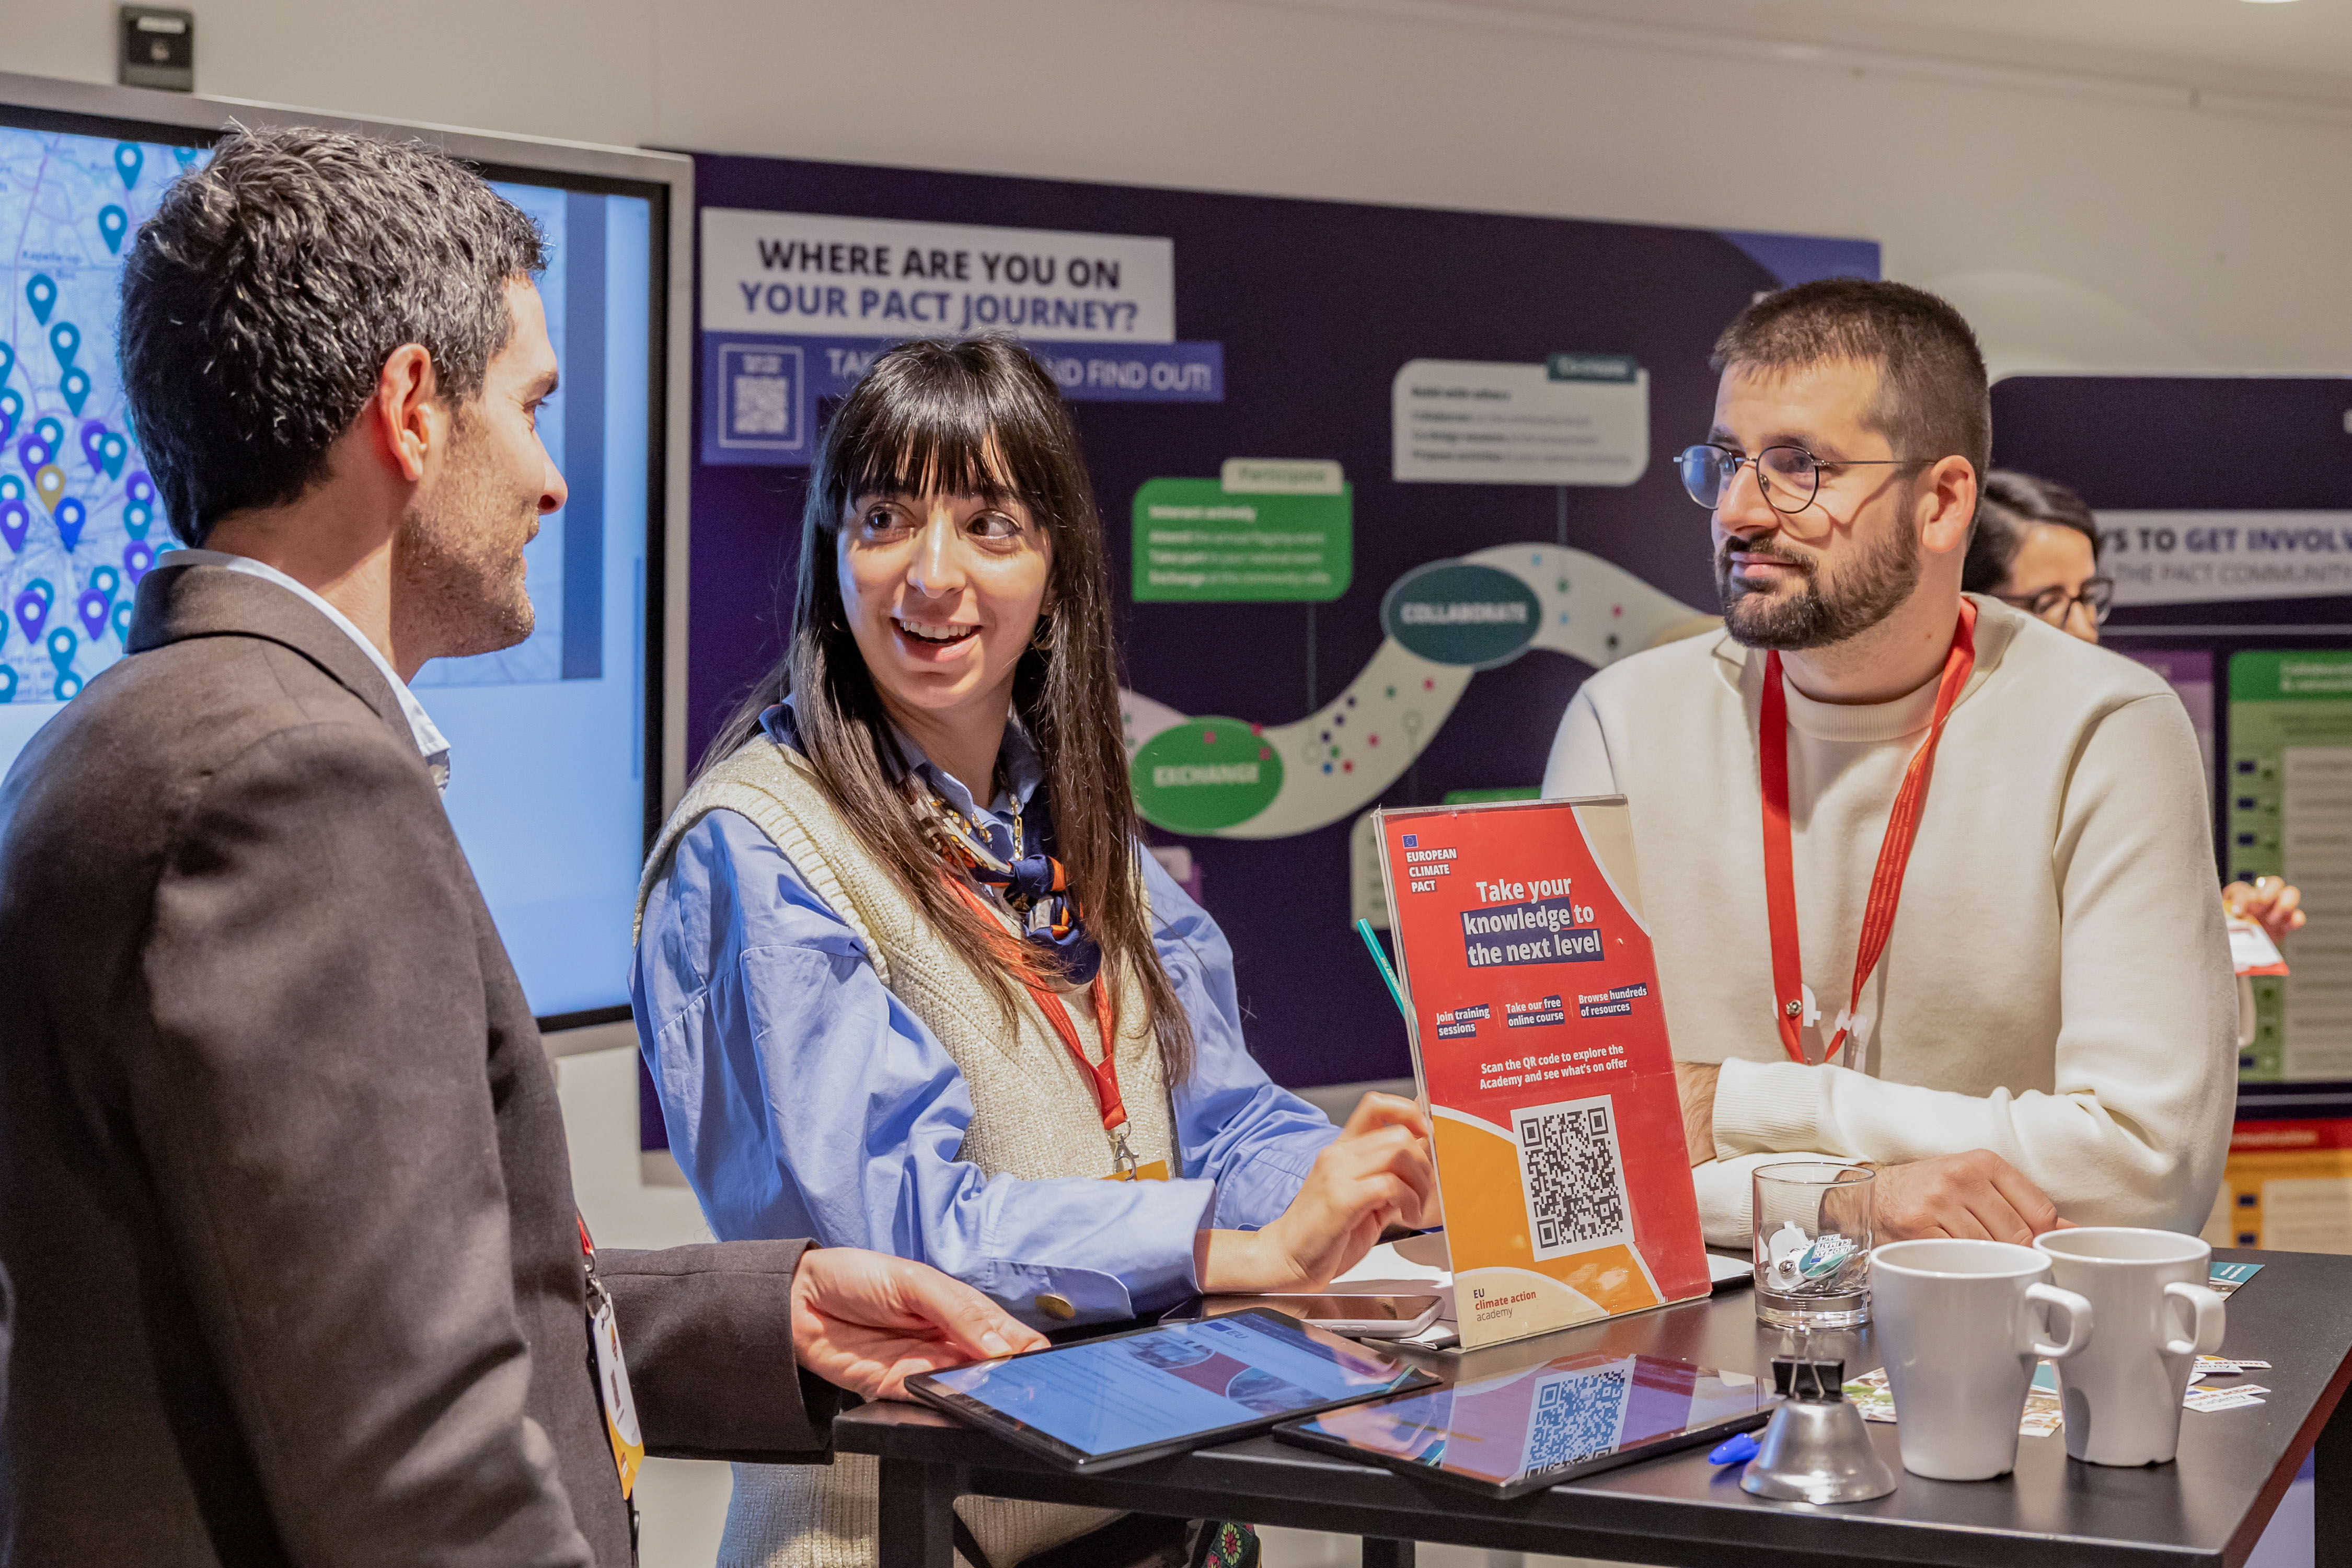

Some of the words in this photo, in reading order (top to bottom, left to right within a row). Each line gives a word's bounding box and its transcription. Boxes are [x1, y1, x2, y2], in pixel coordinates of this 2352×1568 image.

[759, 239, 890, 276] WHERE
[902, 248, 970, 281] ARE
[981, 251, 1055, 286] YOU
[1067, 258, 1120, 290] ON
[739, 280, 848, 317] YOUR
[859, 289, 951, 322] PACT
[959, 293, 1139, 332] JOURNEY?
[1087, 359, 1148, 389] FIND
[1151, 361, 1212, 391] OUT!
[2139, 527, 2176, 553] TO
[2184, 527, 2238, 553] GET
[1400, 602, 1528, 624] COLLABORATE
[1153, 763, 1260, 788] EXCHANGE
[1406, 848, 1457, 862] EUROPEAN
[1409, 864, 1450, 877] CLIMATE
[1411, 880, 1436, 893] PACT
[1475, 879, 1524, 903] Take
[1527, 878, 1572, 904] your
[1463, 905, 1570, 935] knowledge
[1573, 905, 1595, 924] to
[1468, 943, 1502, 966] the
[1506, 938, 1552, 962] next
[1554, 930, 1601, 956] level
[1578, 993, 1609, 1004] Browse
[1609, 986, 1647, 1001] hundreds
[1505, 1003, 1527, 1014] Take
[1527, 1001, 1543, 1011] our
[1542, 997, 1562, 1009] free
[1581, 1006, 1590, 1017] of
[1590, 1002, 1631, 1016] resources
[1436, 1011, 1454, 1025] Join
[1454, 1007, 1491, 1021] training
[1508, 1016, 1536, 1027] online
[1536, 1011, 1564, 1023] course
[1438, 1023, 1477, 1036] sessions
[1481, 1061, 1504, 1075] Scan
[1505, 1058, 1521, 1071] the
[1522, 1056, 1537, 1069] QR
[1538, 1053, 1560, 1065] code
[1561, 1051, 1572, 1062] to
[1572, 1046, 1607, 1062] explore
[1608, 1044, 1624, 1055] the
[1480, 1074, 1523, 1090] Academy
[1524, 1069, 1542, 1083] and
[1543, 1068, 1560, 1080] see
[1560, 1063, 1592, 1078] what's
[1592, 1063, 1605, 1073] on
[1605, 1058, 1628, 1070] offer
[1473, 1288, 1485, 1299] EU
[1475, 1297, 1509, 1310] climate
[1511, 1290, 1537, 1303] action
[1477, 1307, 1513, 1322] academy
[1226, 1330, 1250, 1340] EU
